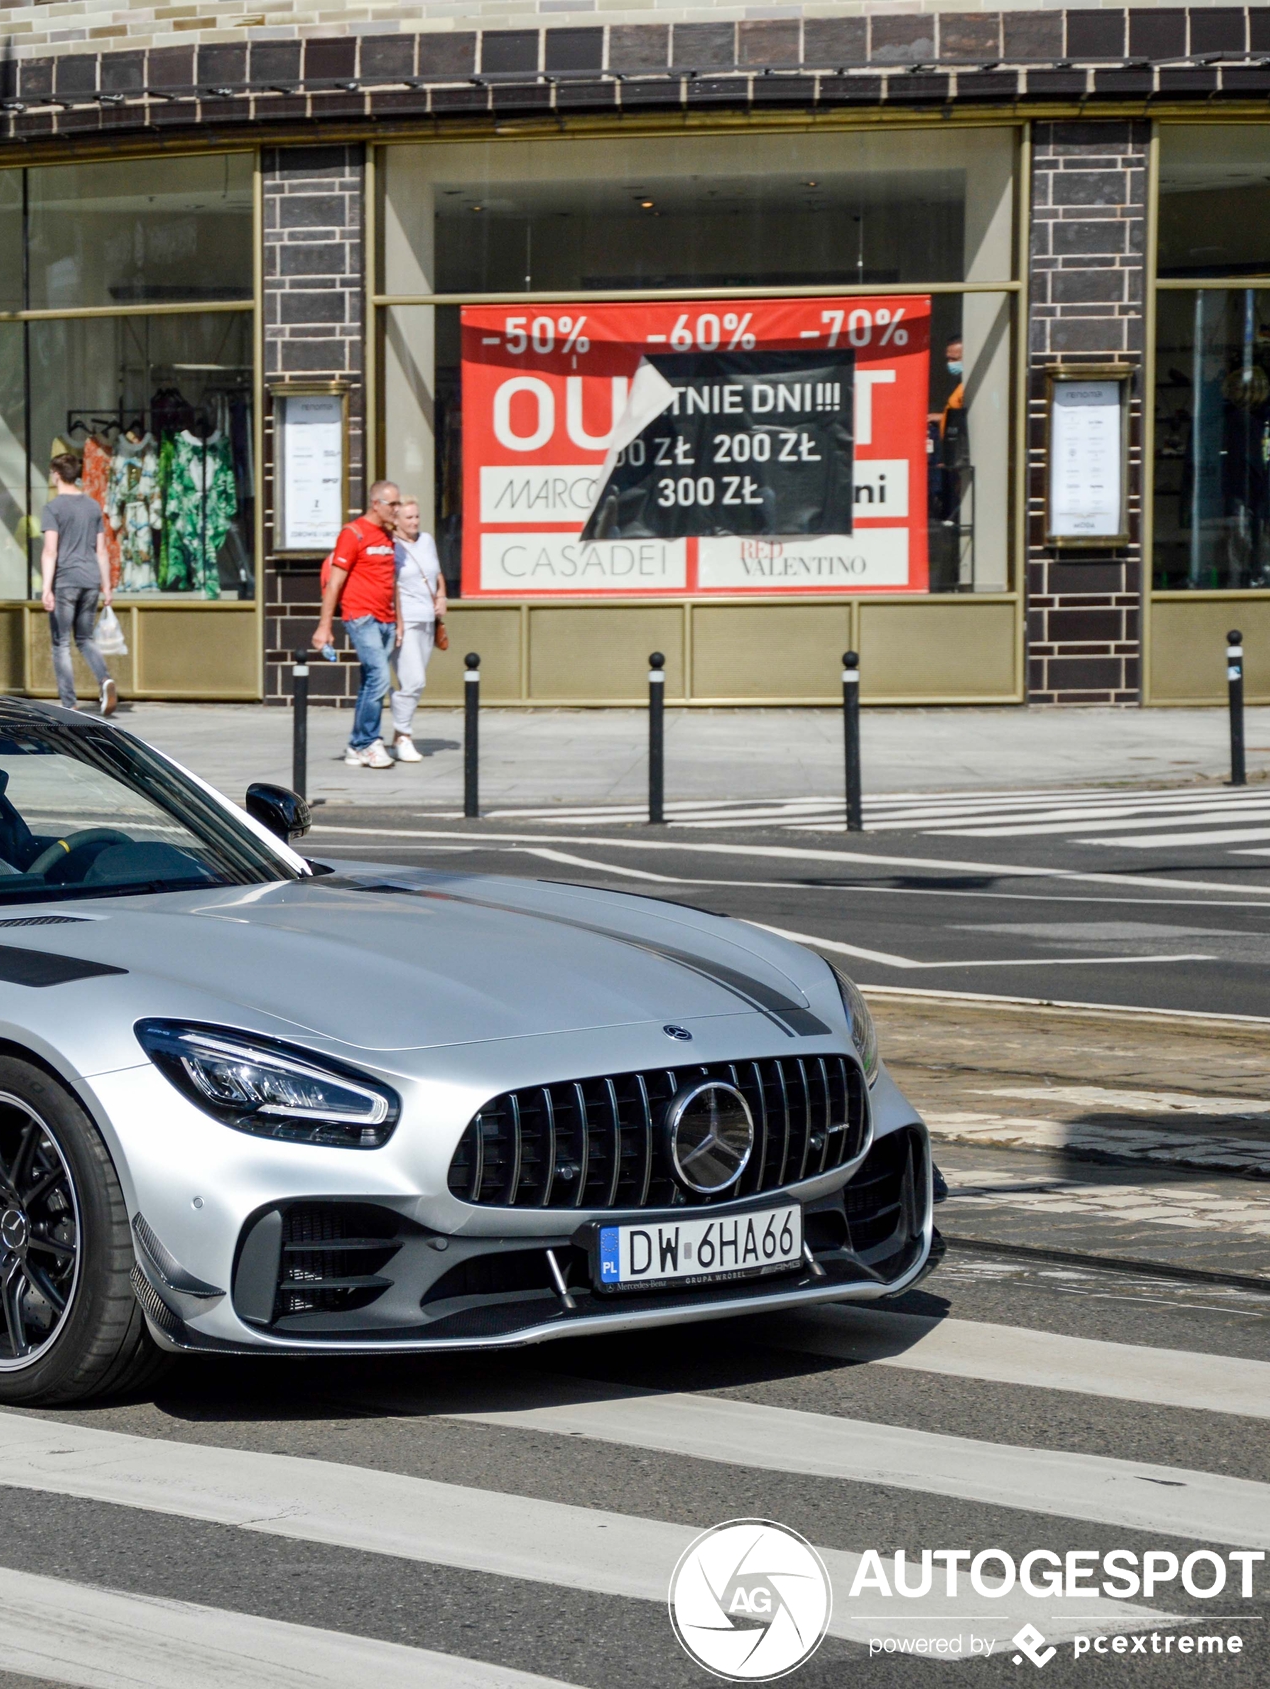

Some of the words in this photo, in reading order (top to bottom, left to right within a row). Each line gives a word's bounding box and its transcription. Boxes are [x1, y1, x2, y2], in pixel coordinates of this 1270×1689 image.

[482, 316, 590, 354] -50%
[647, 312, 756, 351] -60%
[800, 308, 909, 347] -70%
[671, 384, 744, 415] TNIE
[752, 383, 841, 413] DNI!!!
[654, 436, 695, 465] ZŁ
[713, 433, 772, 464] 200
[778, 432, 821, 462] ZŁ
[658, 477, 715, 507] 300
[722, 476, 764, 505] ZŁ
[501, 544, 667, 577] CASADEI
[740, 540, 784, 559] RED
[740, 555, 867, 577] VALENTINO
[629, 1226, 680, 1276] DW
[697, 1210, 794, 1269] 6HA66
[602, 1261, 618, 1274] PL
[617, 1280, 667, 1292] Mercedes-Benz
[685, 1275, 713, 1285] GRUPA
